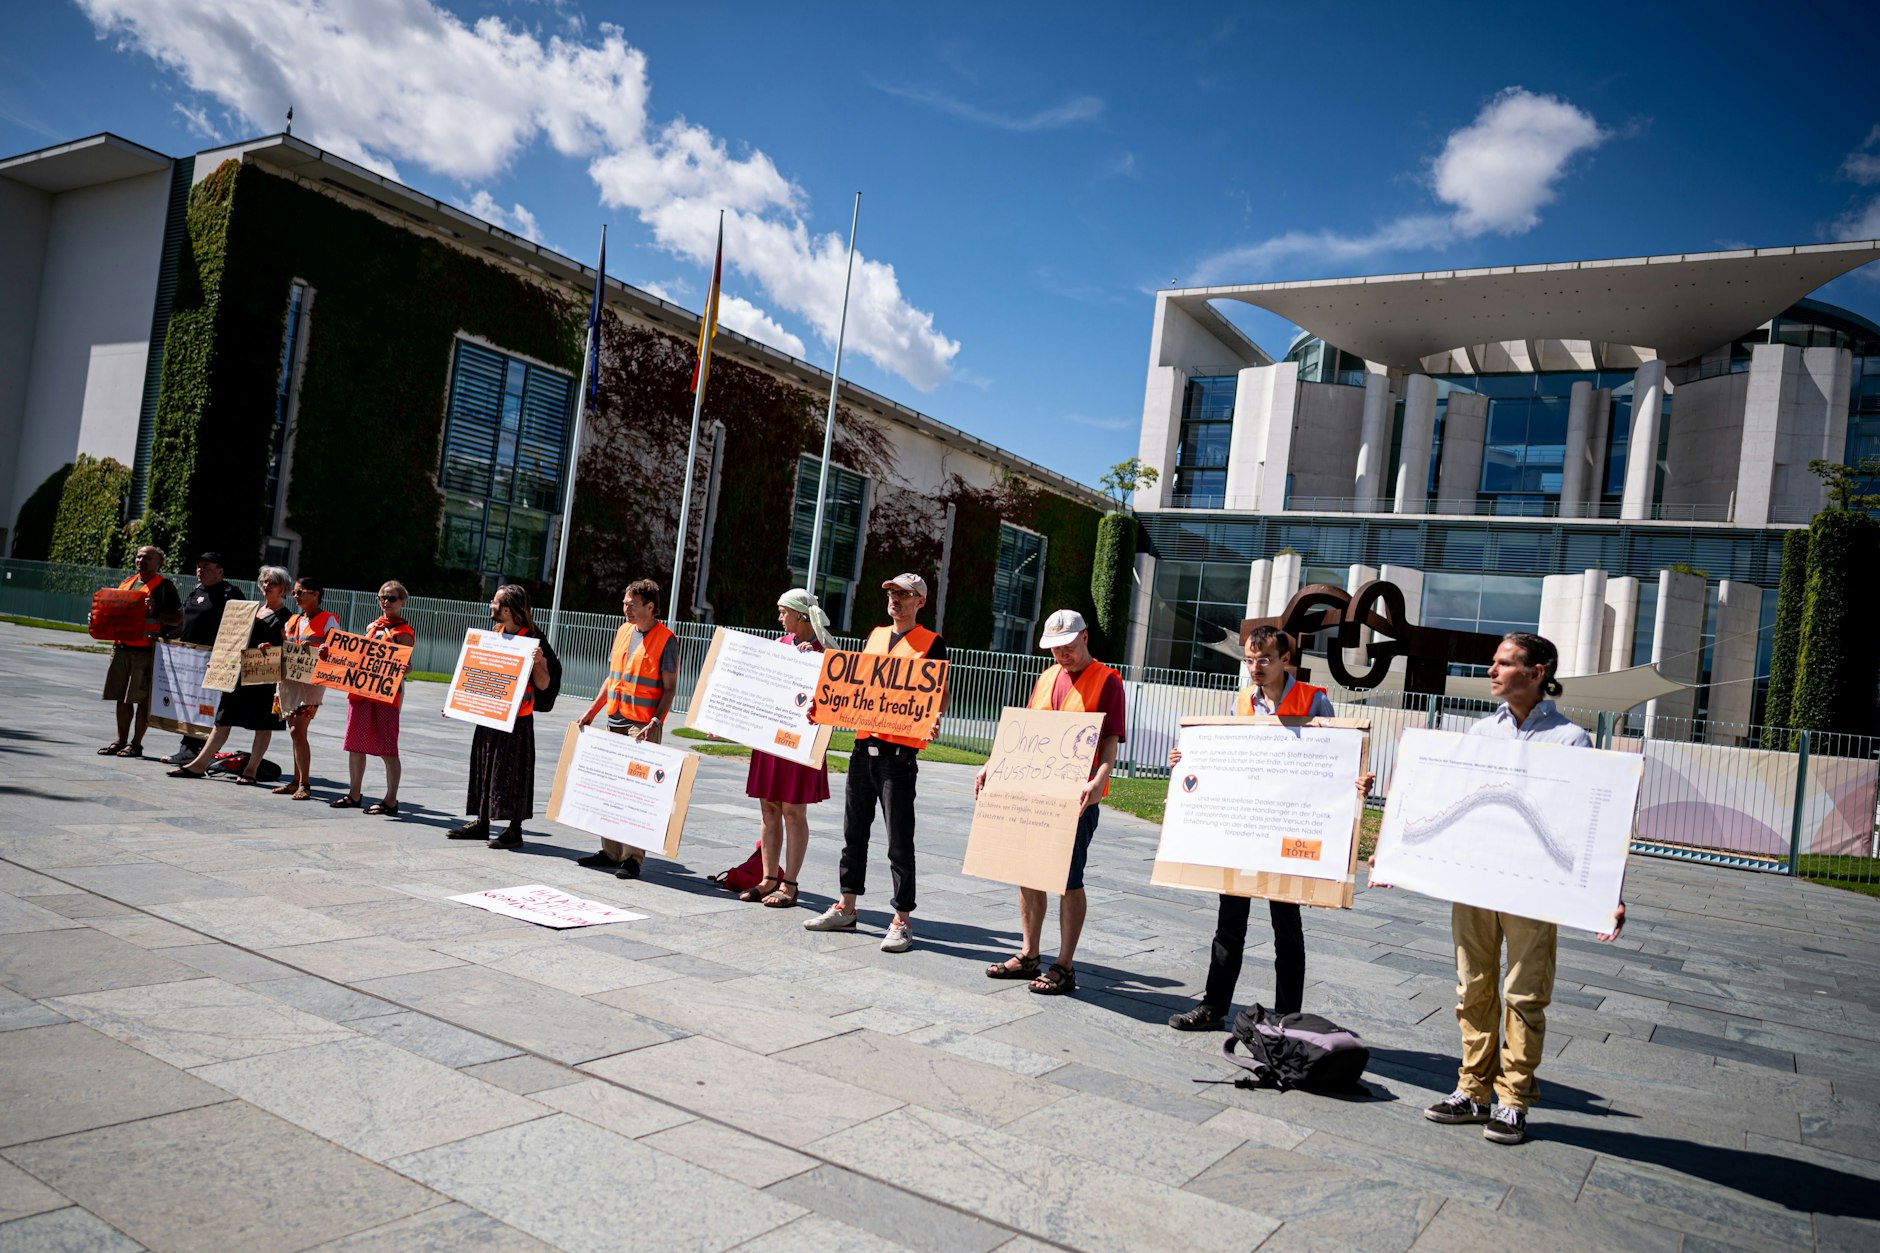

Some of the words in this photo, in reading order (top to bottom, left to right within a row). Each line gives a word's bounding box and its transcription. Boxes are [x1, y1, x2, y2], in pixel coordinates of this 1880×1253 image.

[286, 644, 308, 656] UND
[329, 632, 401, 662] PROTEST...
[288, 664, 312, 674] schaut
[332, 655, 348, 666] nicht
[348, 660, 358, 668] nur
[359, 656, 402, 678] LEGITIM
[827, 652, 864, 685] OIL
[870, 656, 946, 694] KILLS!
[290, 670, 302, 680] ZU
[316, 670, 342, 683] sondern
[818, 684, 849, 712] Sign
[853, 688, 874, 711] the
[880, 692, 934, 722] treaty!
[1003, 720, 1050, 754] Ohne
[1295, 838, 1307, 848] ÖL
[1286, 847, 1316, 858] TÖTET
